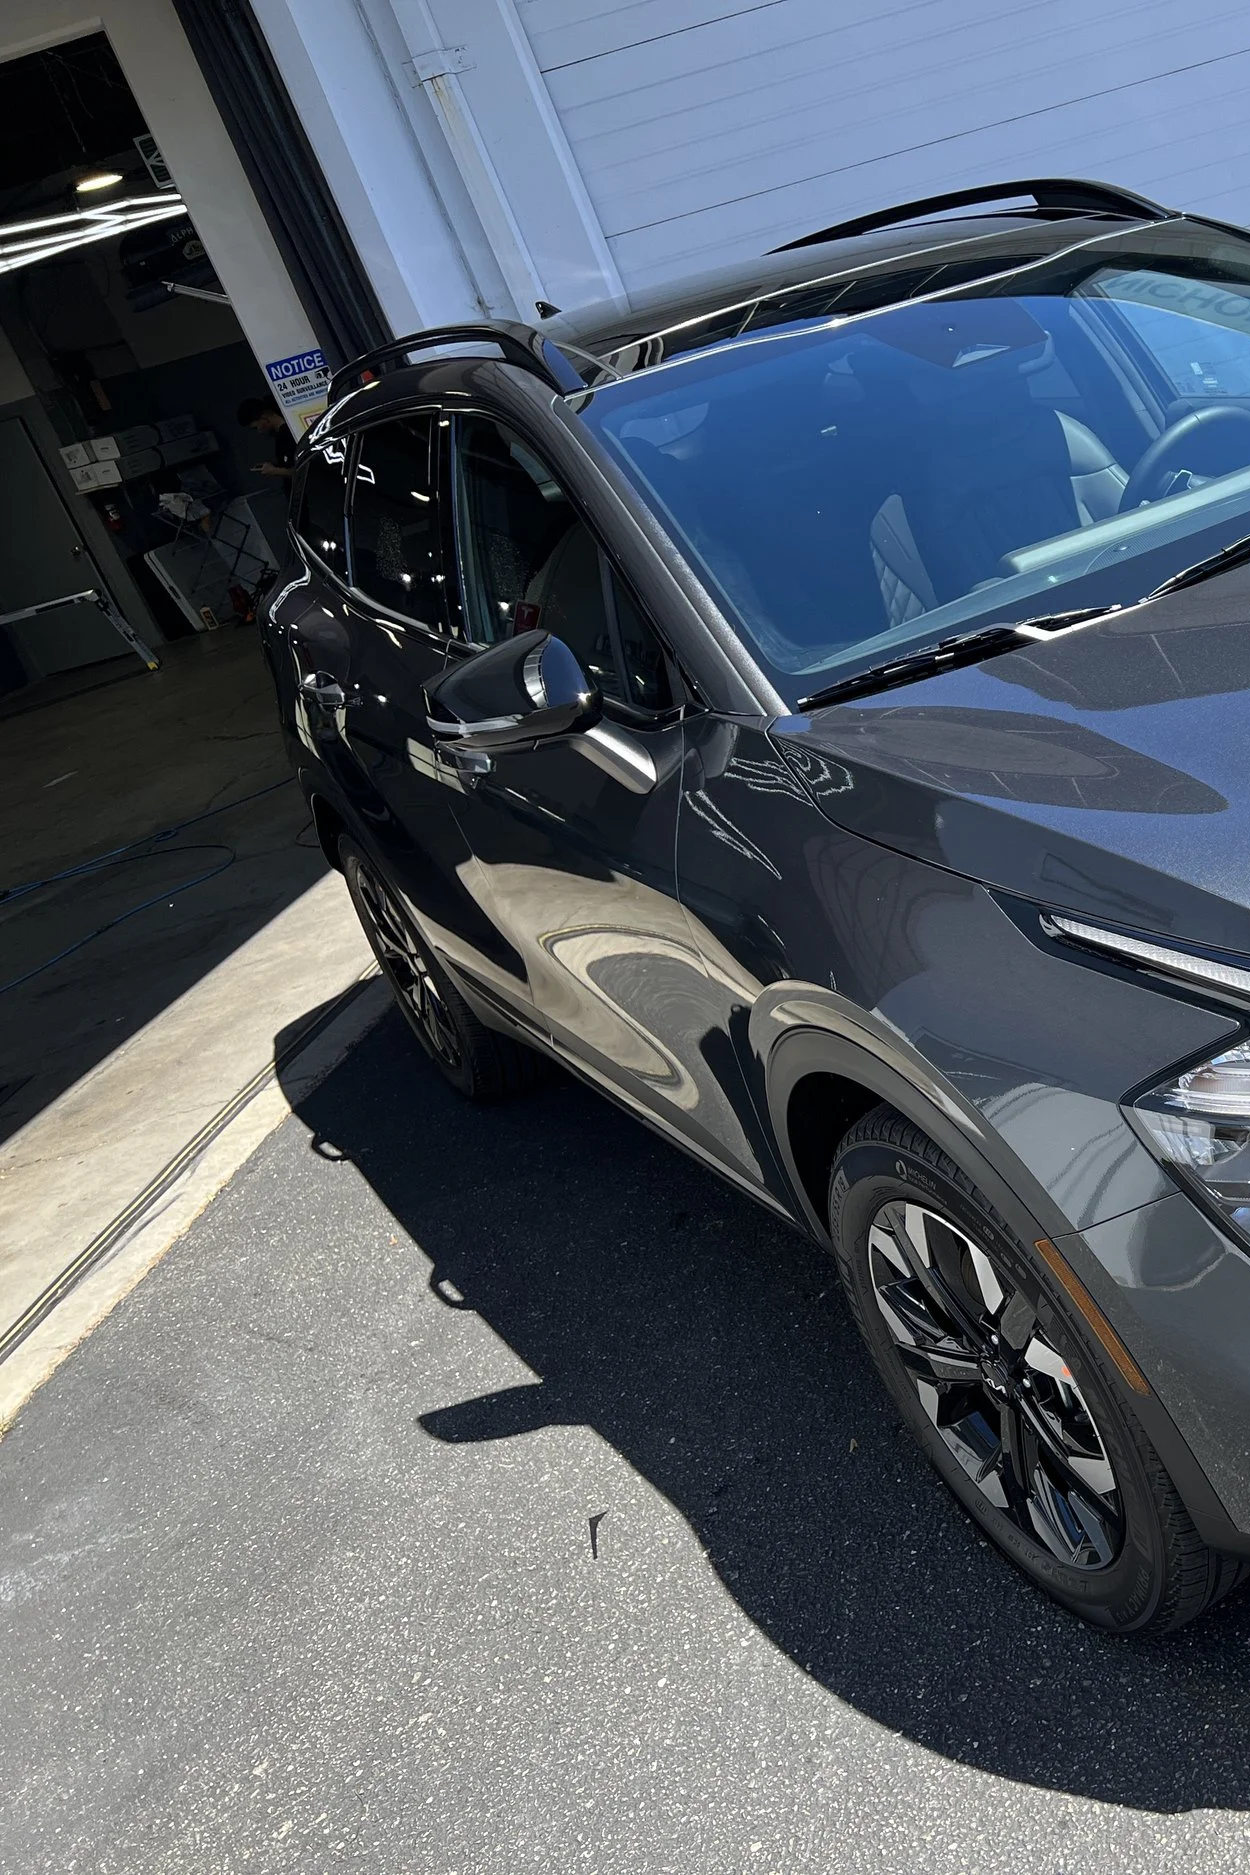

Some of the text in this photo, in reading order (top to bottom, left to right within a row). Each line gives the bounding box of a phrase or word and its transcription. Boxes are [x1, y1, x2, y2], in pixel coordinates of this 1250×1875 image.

[270, 353, 324, 380] NOTICE
[277, 375, 311, 392] 24 HOUR
[281, 390, 296, 399] VIDEO
[908, 1167, 937, 1191] MICHELIN
